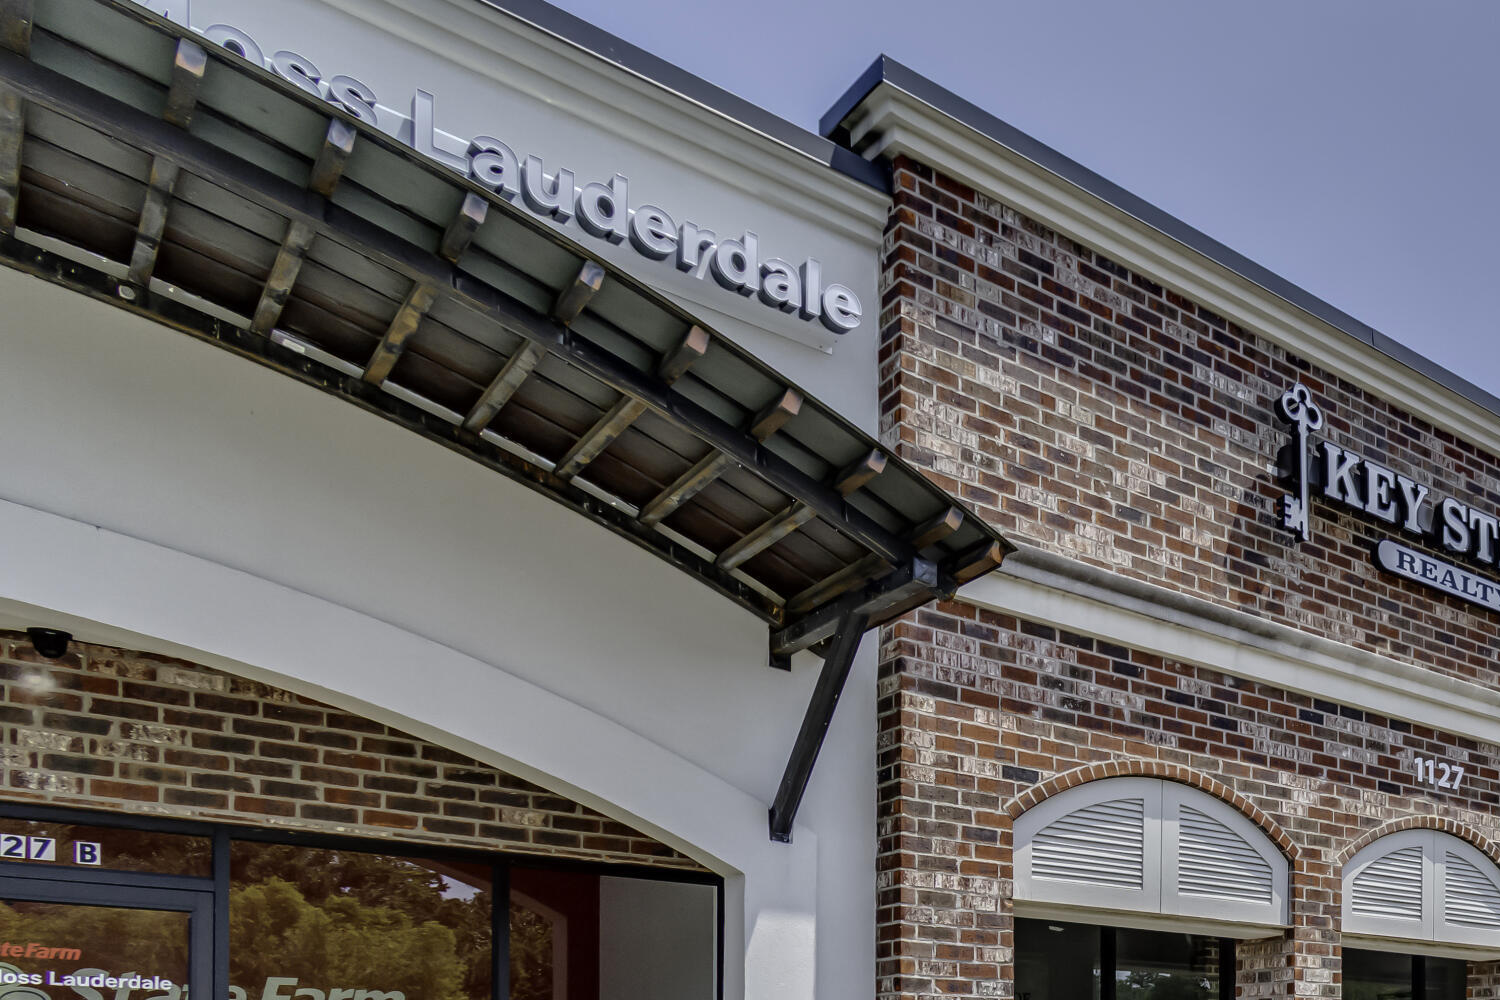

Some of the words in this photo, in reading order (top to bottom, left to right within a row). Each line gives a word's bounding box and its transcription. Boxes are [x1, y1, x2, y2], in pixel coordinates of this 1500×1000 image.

[137, 0, 378, 128] oss
[412, 87, 863, 336] Lauderdale
[1320, 441, 1429, 535] KEY
[1414, 756, 1465, 790] 1127
[79, 843, 98, 864] B
[0, 968, 43, 986] oss
[49, 970, 173, 990] Lauderdale
